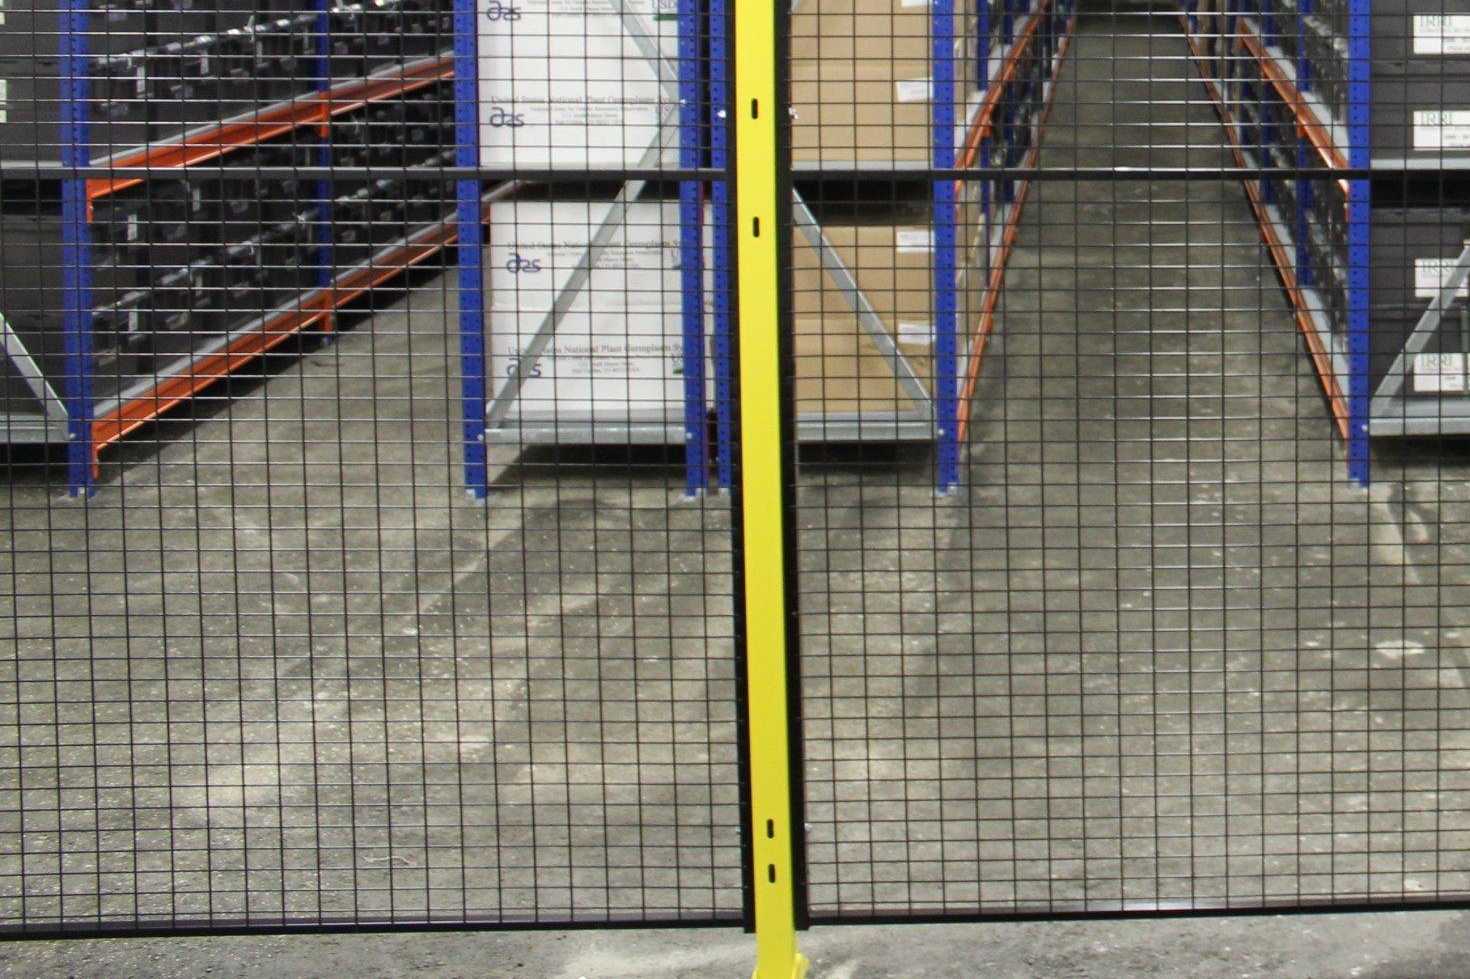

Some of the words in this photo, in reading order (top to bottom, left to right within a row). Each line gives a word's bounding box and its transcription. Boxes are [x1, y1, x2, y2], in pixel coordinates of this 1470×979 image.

[651, 0, 676, 10] USD
[1420, 15, 1452, 28] IRRI
[1420, 112, 1453, 126] IRRI
[601, 345, 622, 354] Plant
[1421, 355, 1452, 367] IRRI
